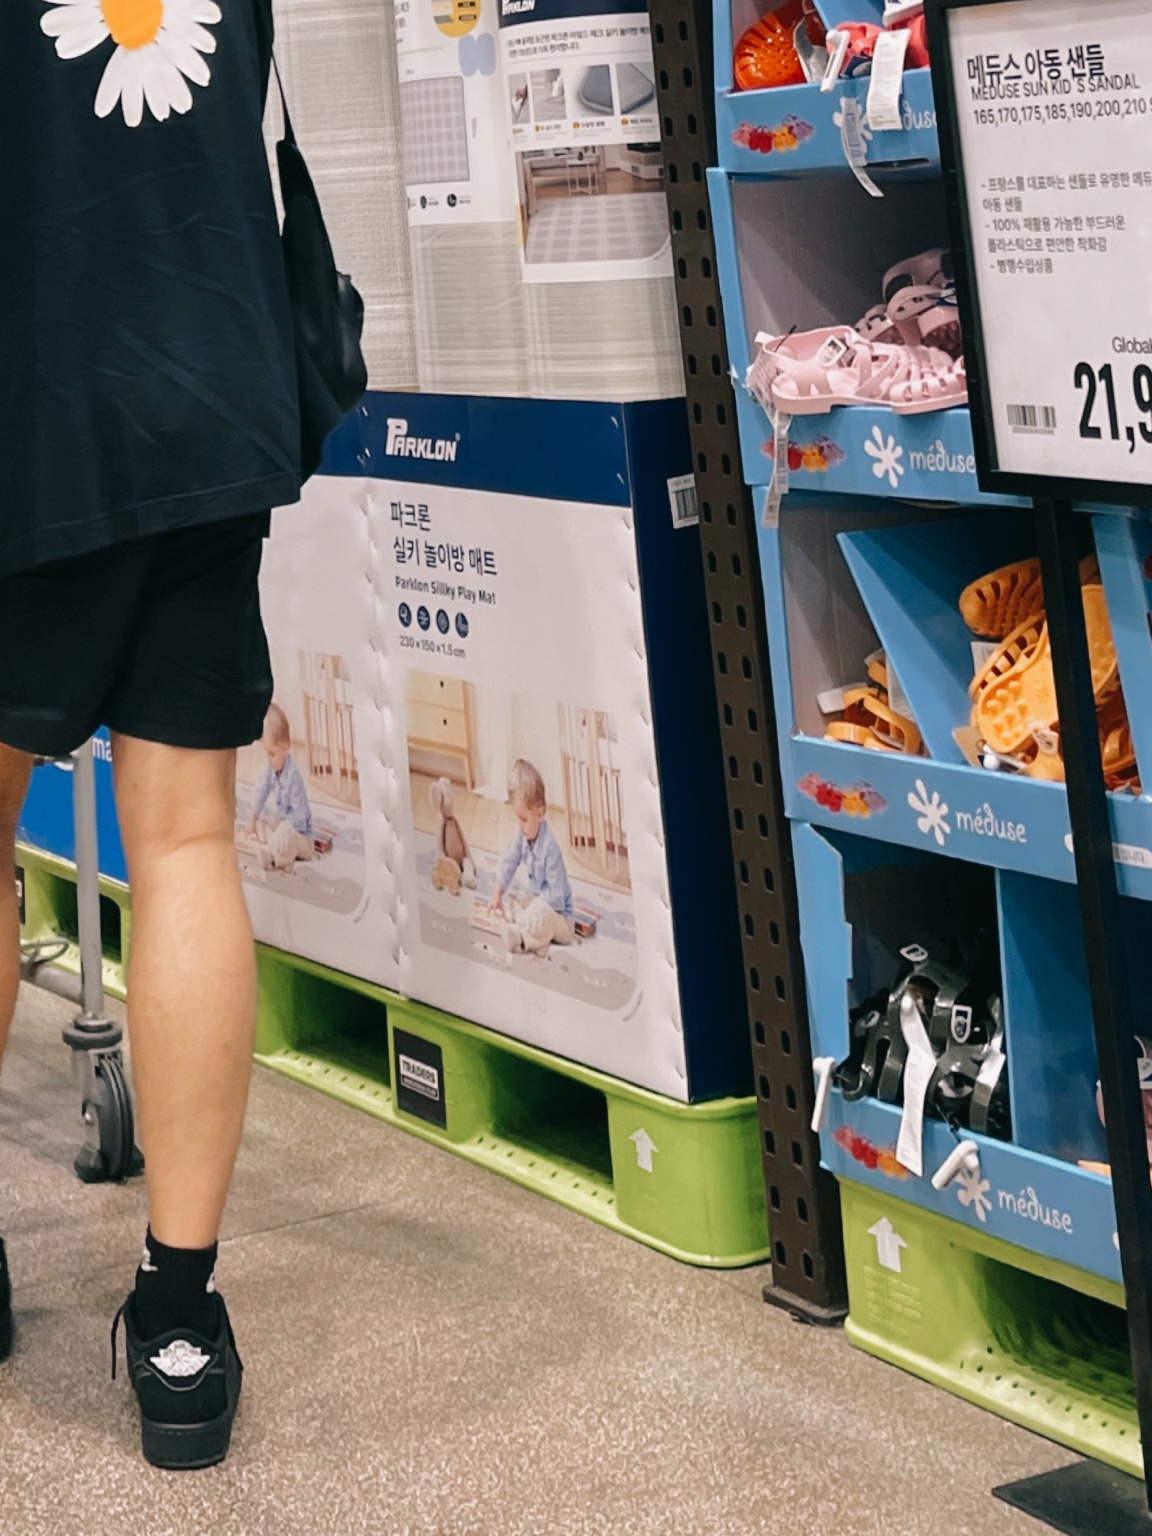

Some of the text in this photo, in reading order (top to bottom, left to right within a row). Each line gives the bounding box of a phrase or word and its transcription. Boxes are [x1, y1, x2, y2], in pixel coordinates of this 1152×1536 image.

[967, 43, 1105, 88] 메듀스 아동 샌들
[971, 81, 1021, 101] MEDUSE
[1023, 79, 1049, 97] SUN
[1089, 73, 1141, 93] SANDAL
[988, 175, 1026, 192] 프랑스를
[1027, 174, 1066, 190] 대표하는
[1099, 172, 1131, 188] 유명한
[982, 197, 1002, 213] 아동
[992, 214, 1126, 232] 100% 재활용 가능한 부드러운
[987, 236, 1107, 253] 플라스틱으로 편안한 착화감
[385, 417, 458, 462] PARKLON
[390, 501, 431, 531] 파크론
[393, 536, 498, 576] 실키 놀이방 매트
[395, 575, 429, 592] Parklon
[457, 585, 476, 605] Play
[479, 589, 496, 606] Mat
[399, 635, 415, 649] 230
[955, 802, 1027, 844] méduse
[401, 1059, 436, 1085] TRADERS
[998, 1186, 1074, 1234] méduse
